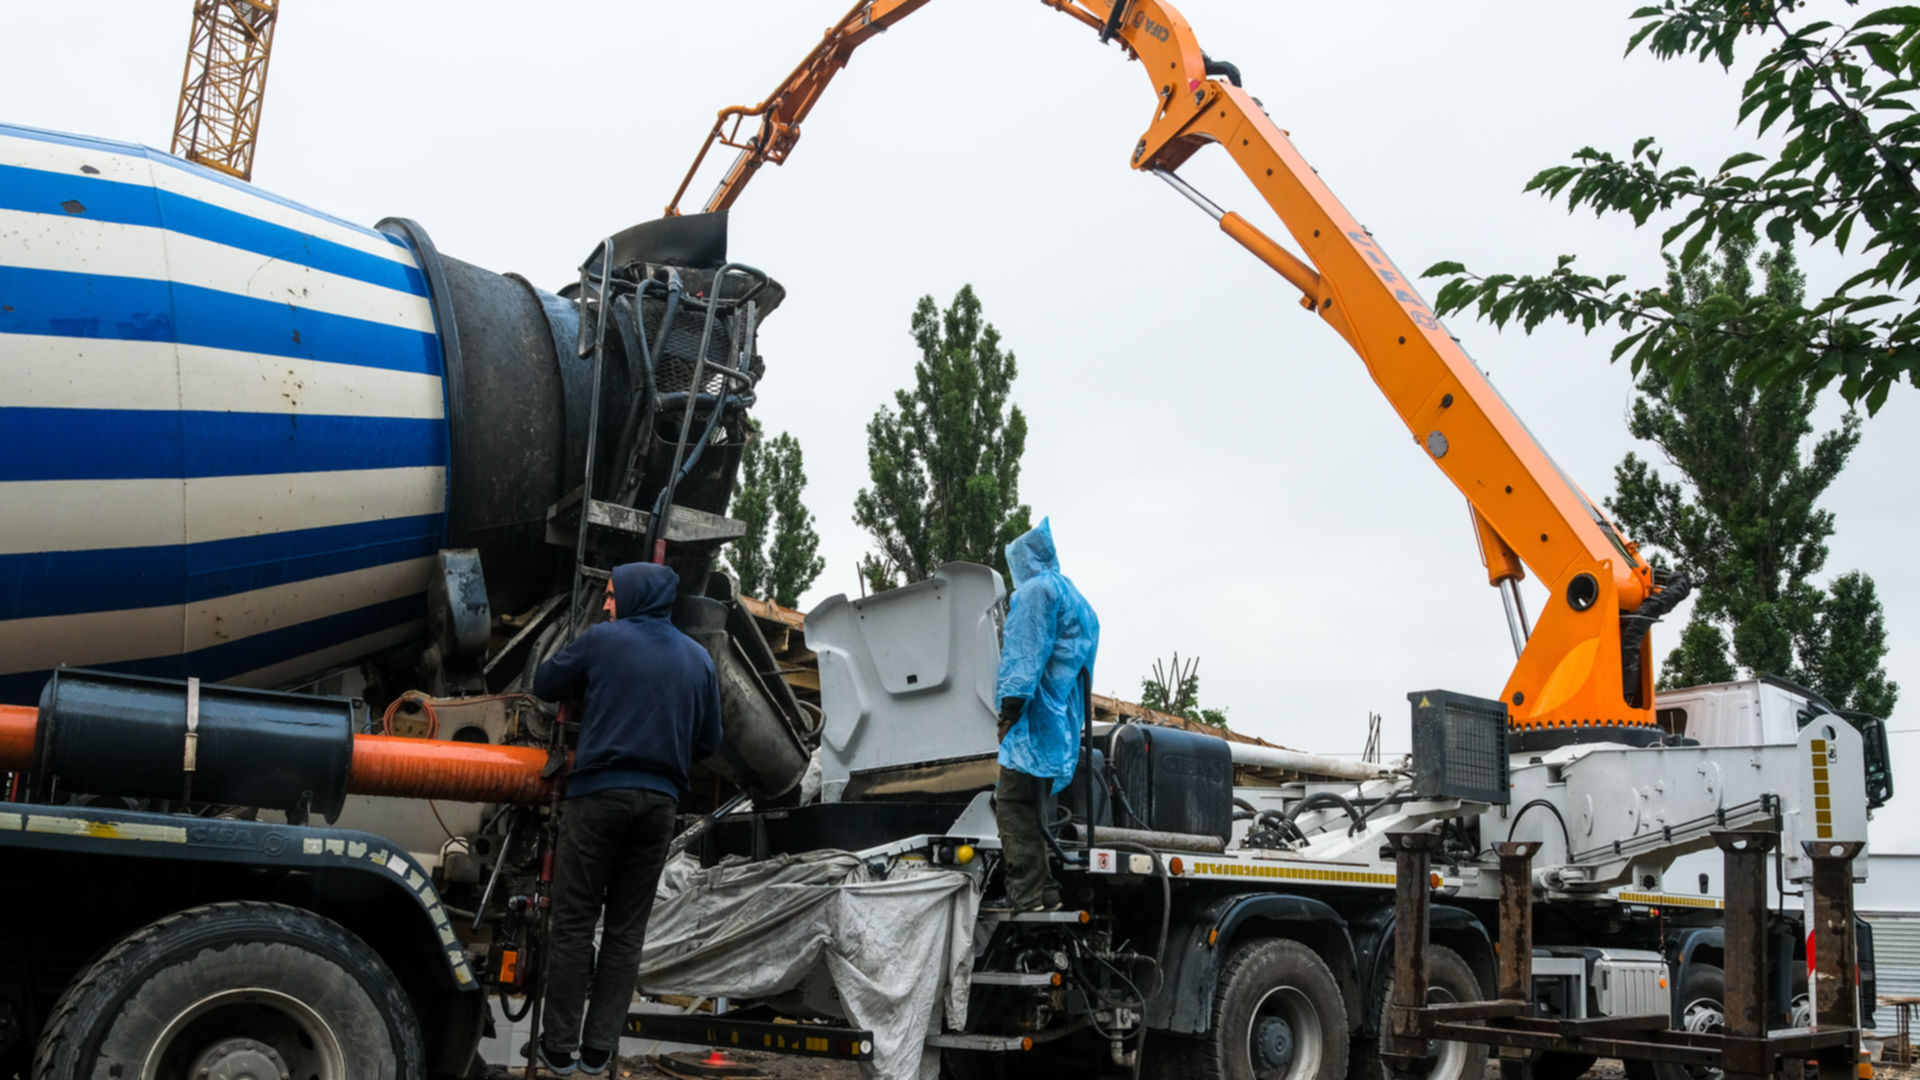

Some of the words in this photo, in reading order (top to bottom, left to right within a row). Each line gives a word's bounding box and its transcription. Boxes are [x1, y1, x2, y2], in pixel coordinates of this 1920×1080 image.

[1144, 17, 1169, 43] CIFA
[1347, 231, 1423, 307] CIFA
[189, 826, 256, 844] CIFA
